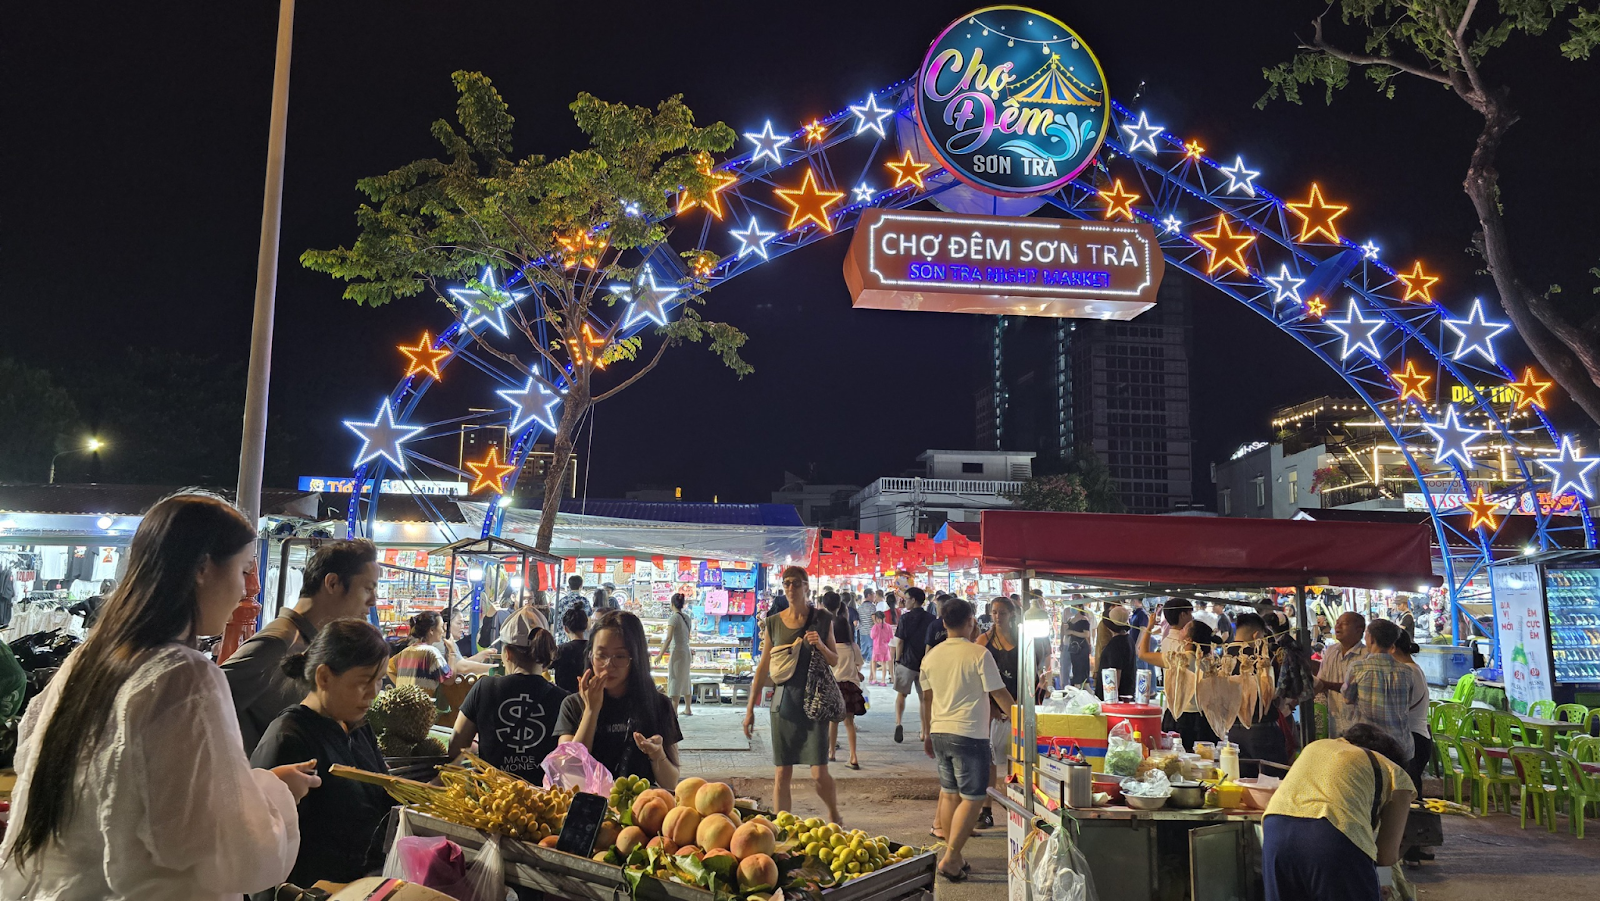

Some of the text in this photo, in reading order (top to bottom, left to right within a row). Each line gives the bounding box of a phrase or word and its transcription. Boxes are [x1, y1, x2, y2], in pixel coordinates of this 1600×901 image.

[943, 91, 1054, 155] Đêm
[973, 154, 1058, 177] SƠN TRÀ
[881, 231, 1139, 267] CHỢ ĐÊM SƠN TRÀ
[909, 263, 1110, 288] SON TRA NIGHT MARKET
[1527, 607, 1538, 618] ÊM
[1530, 629, 1540, 640] ÊM
[500, 763, 541, 773] MONEY
[503, 755, 536, 765] MADE
